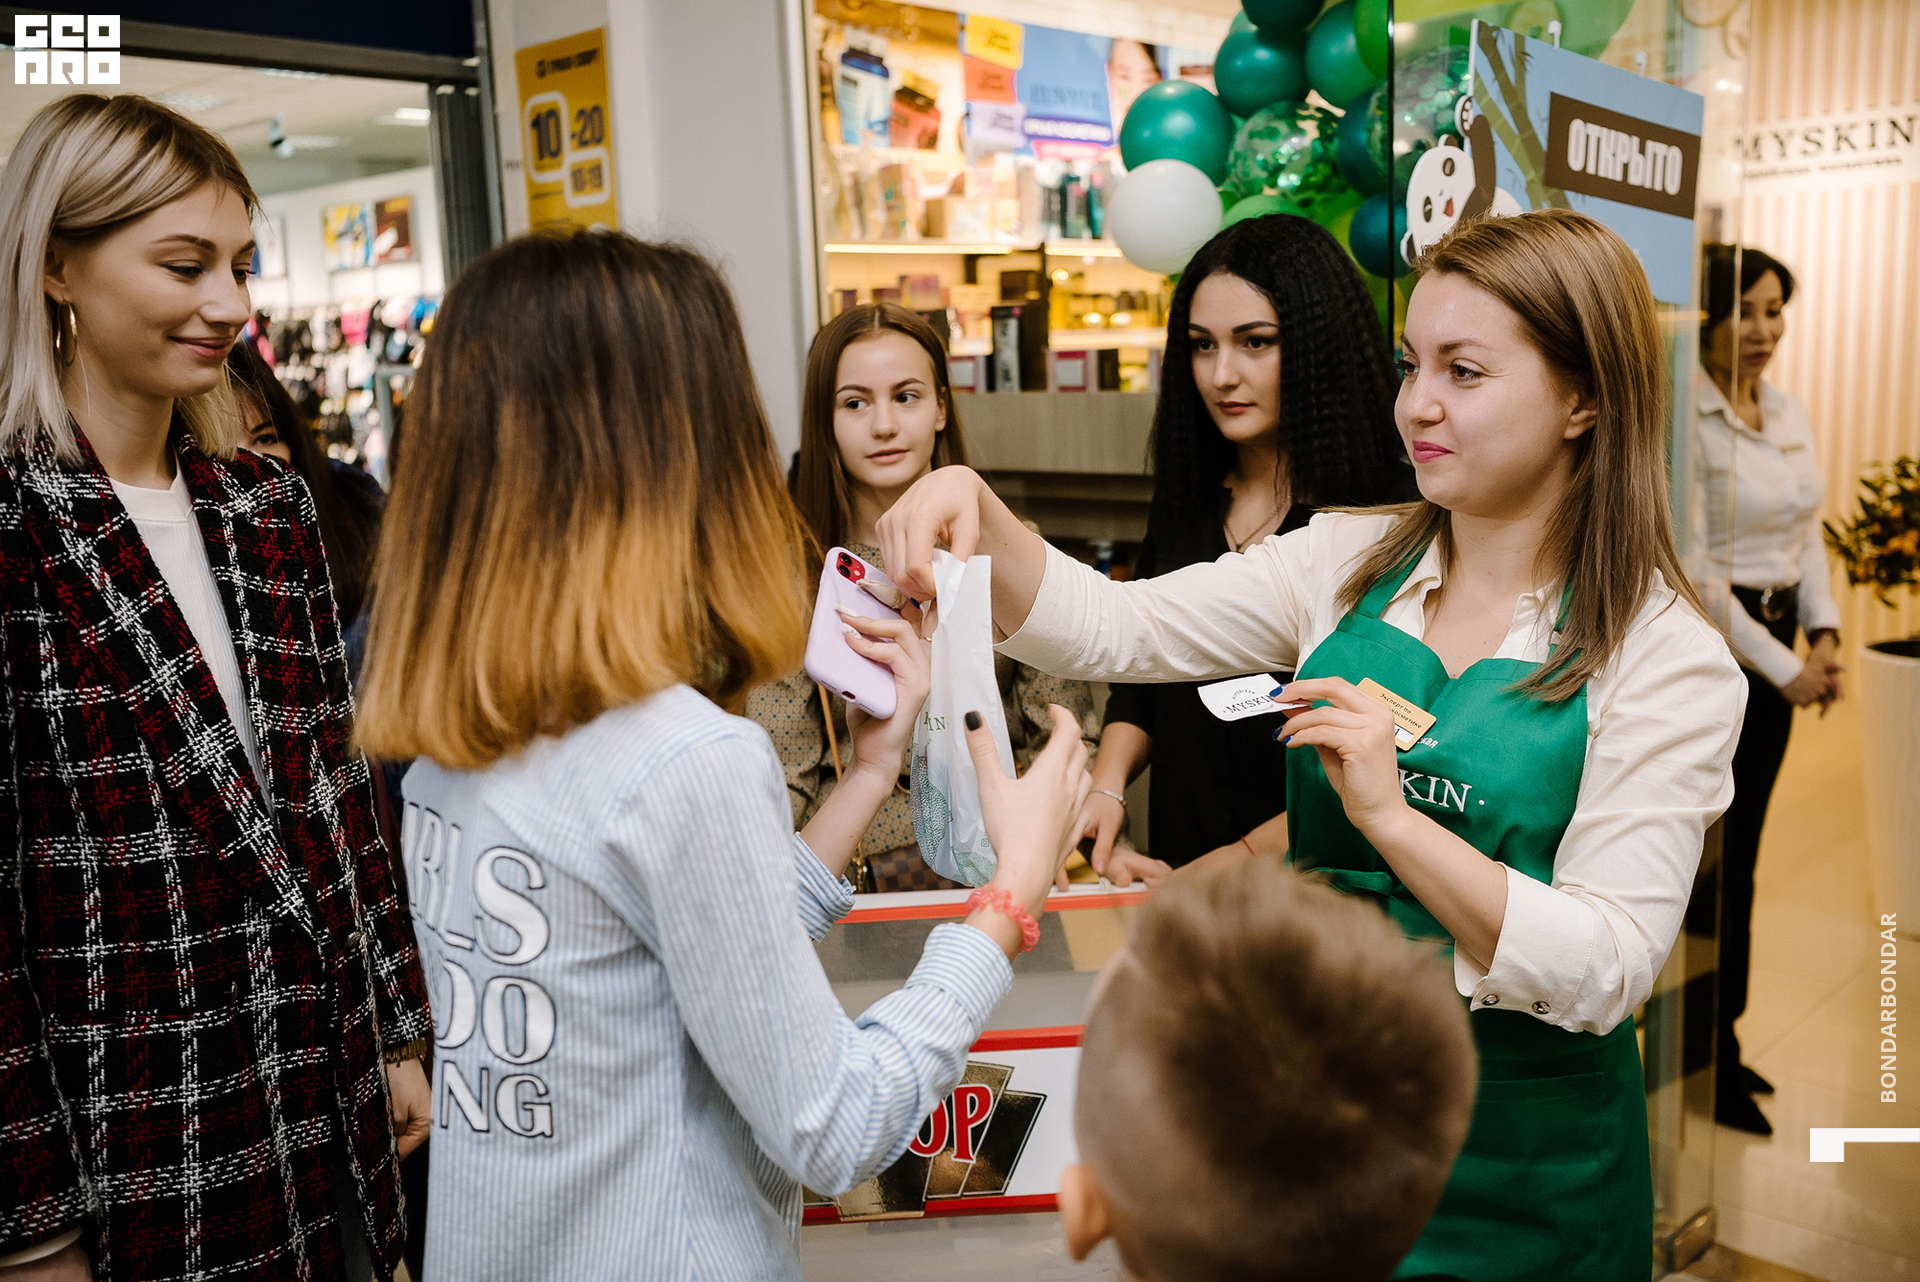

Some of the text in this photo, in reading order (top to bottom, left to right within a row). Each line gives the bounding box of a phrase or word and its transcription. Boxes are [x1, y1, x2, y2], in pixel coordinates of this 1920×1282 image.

[531, 108, 562, 160] 10
[1567, 118, 1683, 195] ОТКРЫТО
[1735, 116, 1915, 160] MYSKIN
[1379, 693, 1412, 715] Эксперт по
